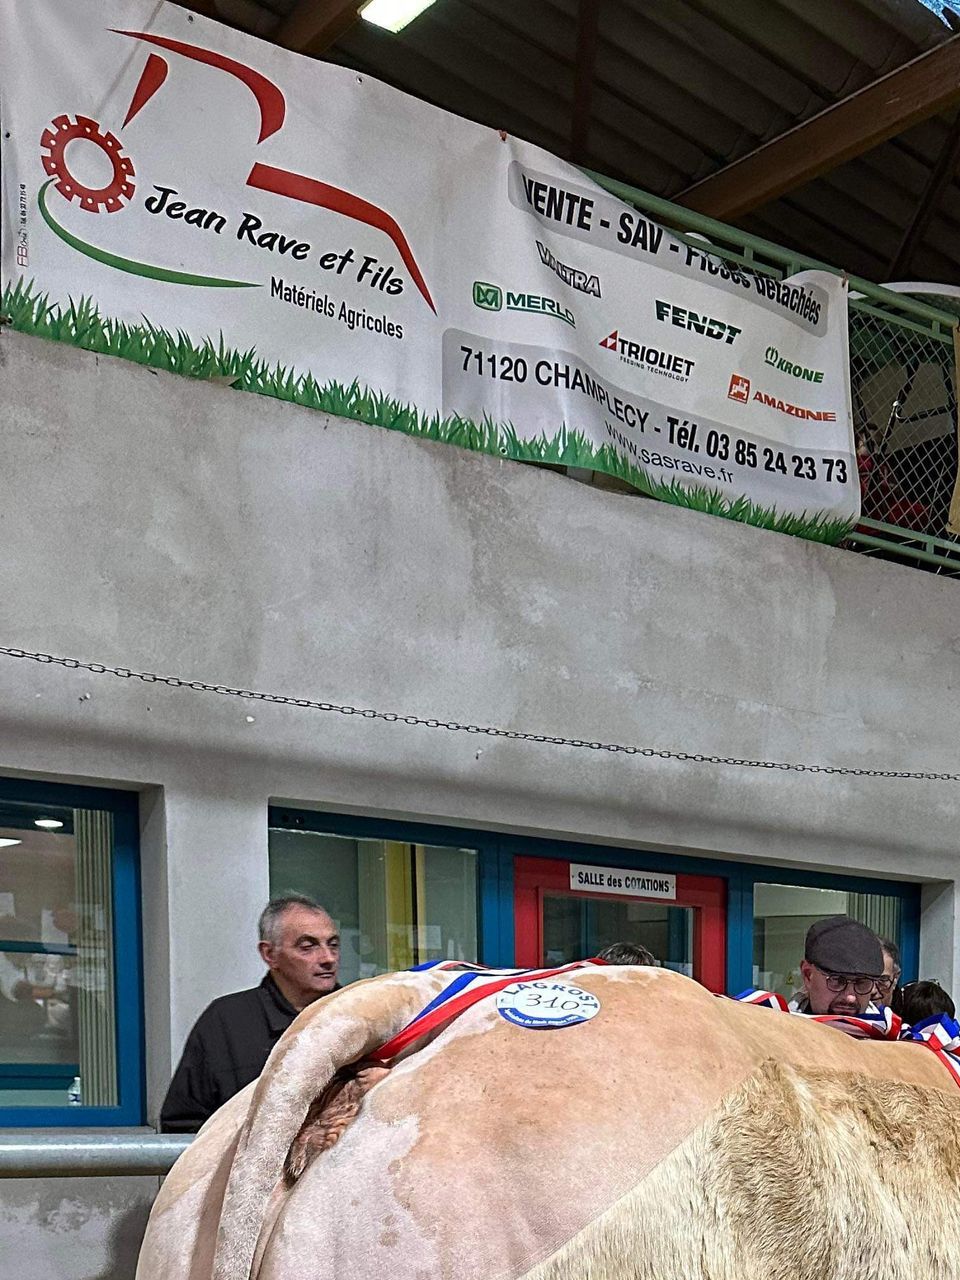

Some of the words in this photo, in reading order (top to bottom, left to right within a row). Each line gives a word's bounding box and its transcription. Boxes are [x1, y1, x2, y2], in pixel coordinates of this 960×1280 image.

[522, 174, 595, 231] VENTE
[600, 219, 610, 229] -
[617, 212, 663, 254] SAV
[144, 184, 227, 234] Jean
[237, 212, 311, 260] Rave
[319, 249, 354, 275] et
[356, 255, 404, 295] Fils
[535, 240, 601, 298] VALTRA
[271, 276, 335, 318] Matériels
[338, 301, 404, 340] Agricoles
[506, 292, 575, 325] MERLO
[655, 300, 742, 345] FENDT
[618, 338, 695, 376] TRIOLIET
[620, 356, 645, 369] FEEDING
[647, 366, 688, 382] TECHNOLOGY
[777, 358, 824, 383] KRONE
[460, 346, 527, 383] 71120
[535, 361, 649, 432] CHAMPLECY
[667, 416, 700, 453] Tél.
[706, 430, 730, 461] 03
[735, 439, 757, 468] 85
[763, 448, 787, 475] 24
[792, 456, 817, 480] 23
[822, 459, 847, 484] 73
[753, 391, 836, 422] AMAZONE
[605, 421, 734, 484] www.sasrave.fr
[578, 872, 604, 886] SALLE
[607, 875, 622, 888] des
[625, 877, 670, 893] COTATIONS
[503, 982, 598, 1008] LAGROST
[526, 994, 579, 1010] 310
